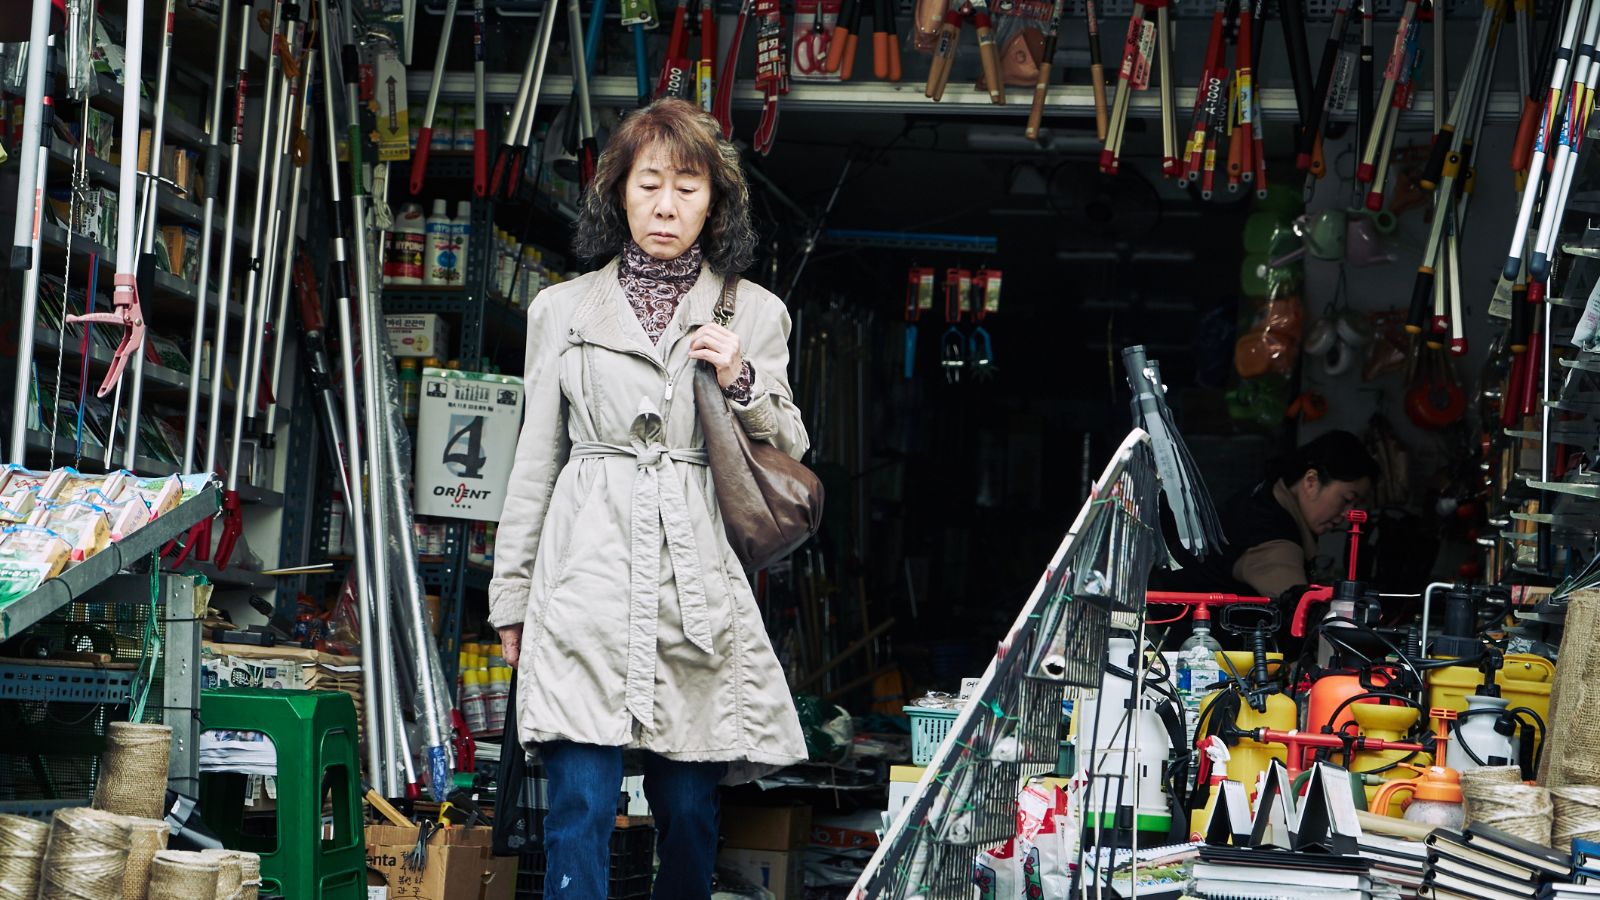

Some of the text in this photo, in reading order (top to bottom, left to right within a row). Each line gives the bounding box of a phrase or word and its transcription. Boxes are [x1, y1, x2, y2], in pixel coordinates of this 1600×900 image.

[667, 67, 682, 96] -1000
[1205, 77, 1221, 115] A-1000
[442, 415, 487, 479] 4
[433, 485, 491, 501] ORIENT
